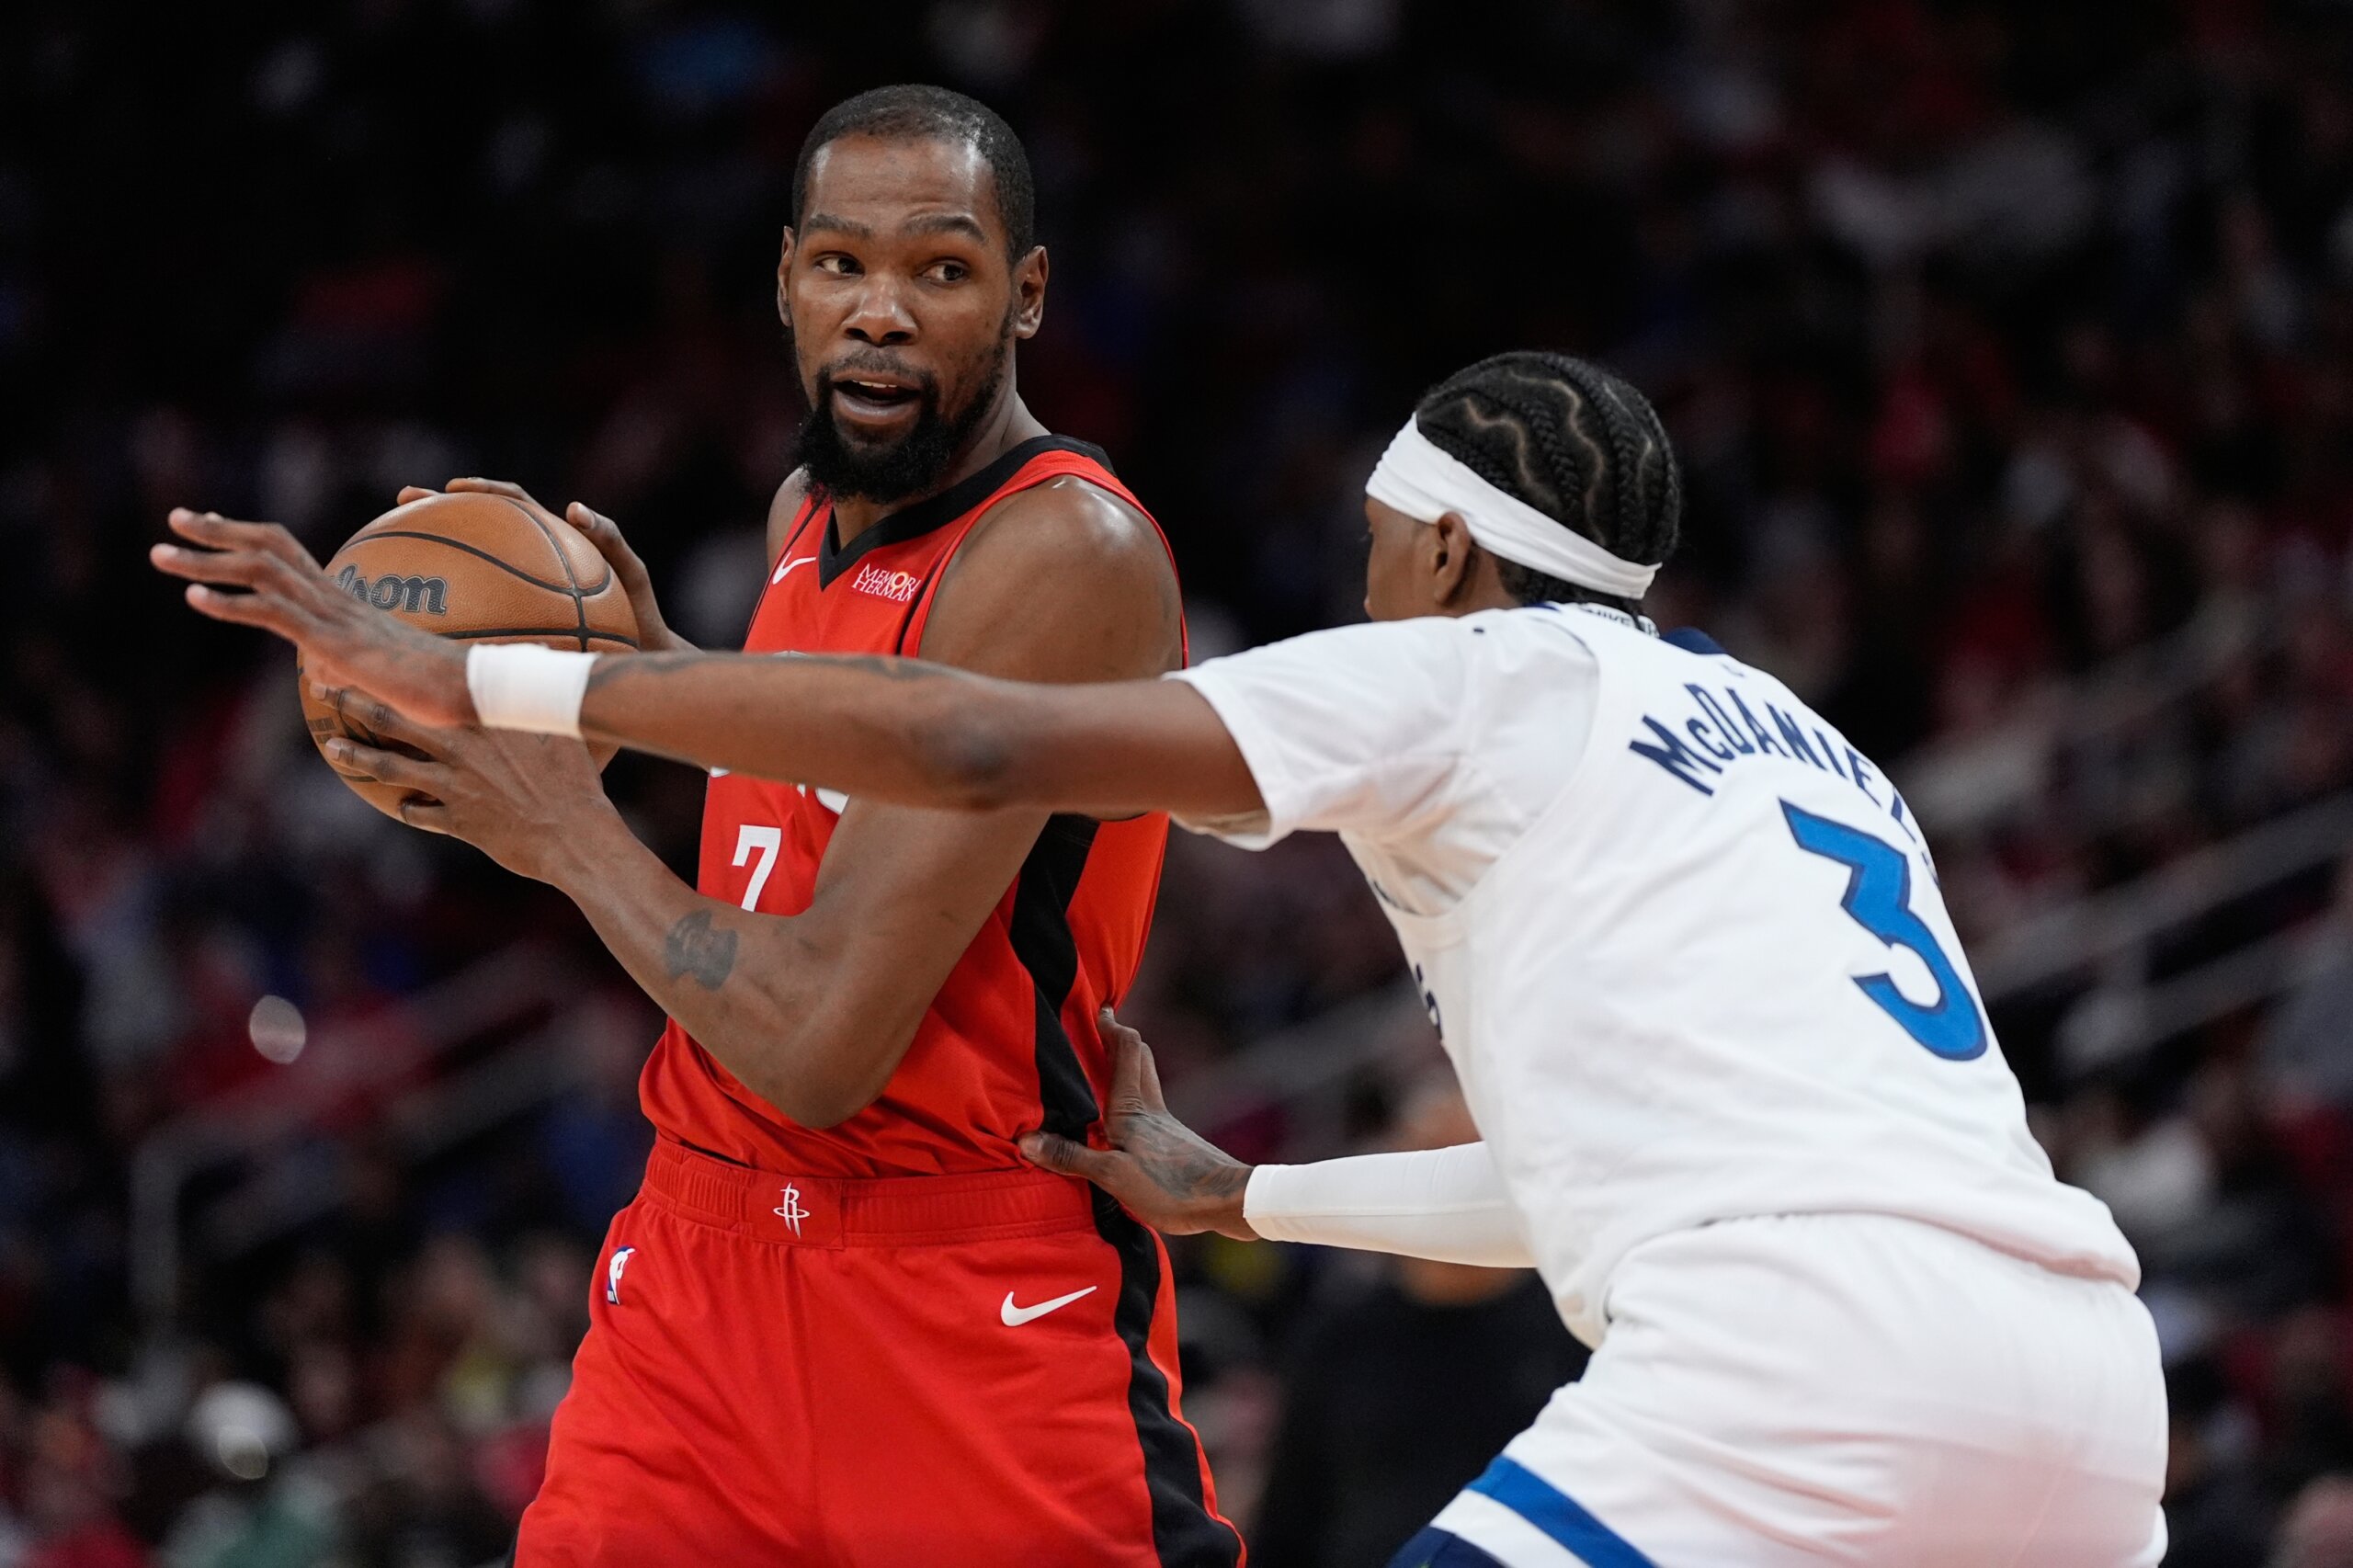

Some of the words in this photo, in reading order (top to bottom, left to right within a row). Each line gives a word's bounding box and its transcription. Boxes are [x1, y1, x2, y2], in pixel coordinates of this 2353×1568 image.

[336, 562, 448, 616] lson
[858, 562, 921, 591] MEMORI
[732, 824, 781, 913] 7
[1778, 795, 1988, 1062] 3
